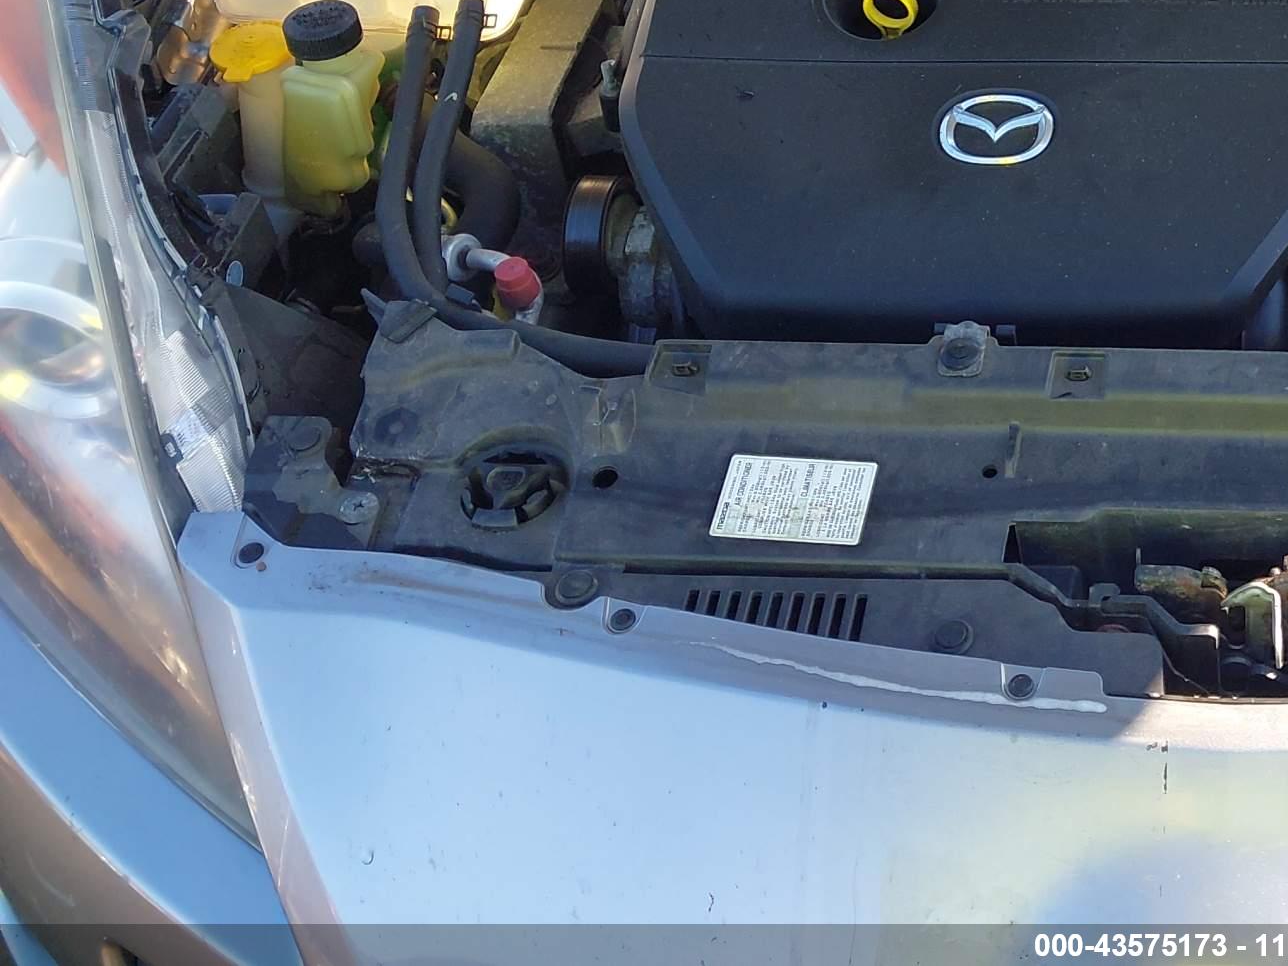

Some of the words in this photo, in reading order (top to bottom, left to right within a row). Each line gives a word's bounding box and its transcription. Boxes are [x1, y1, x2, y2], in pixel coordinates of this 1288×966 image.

[738, 462, 753, 495] CONDITIONER
[800, 463, 816, 497] CLIMATISEUR
[716, 501, 730, 530] mazda
